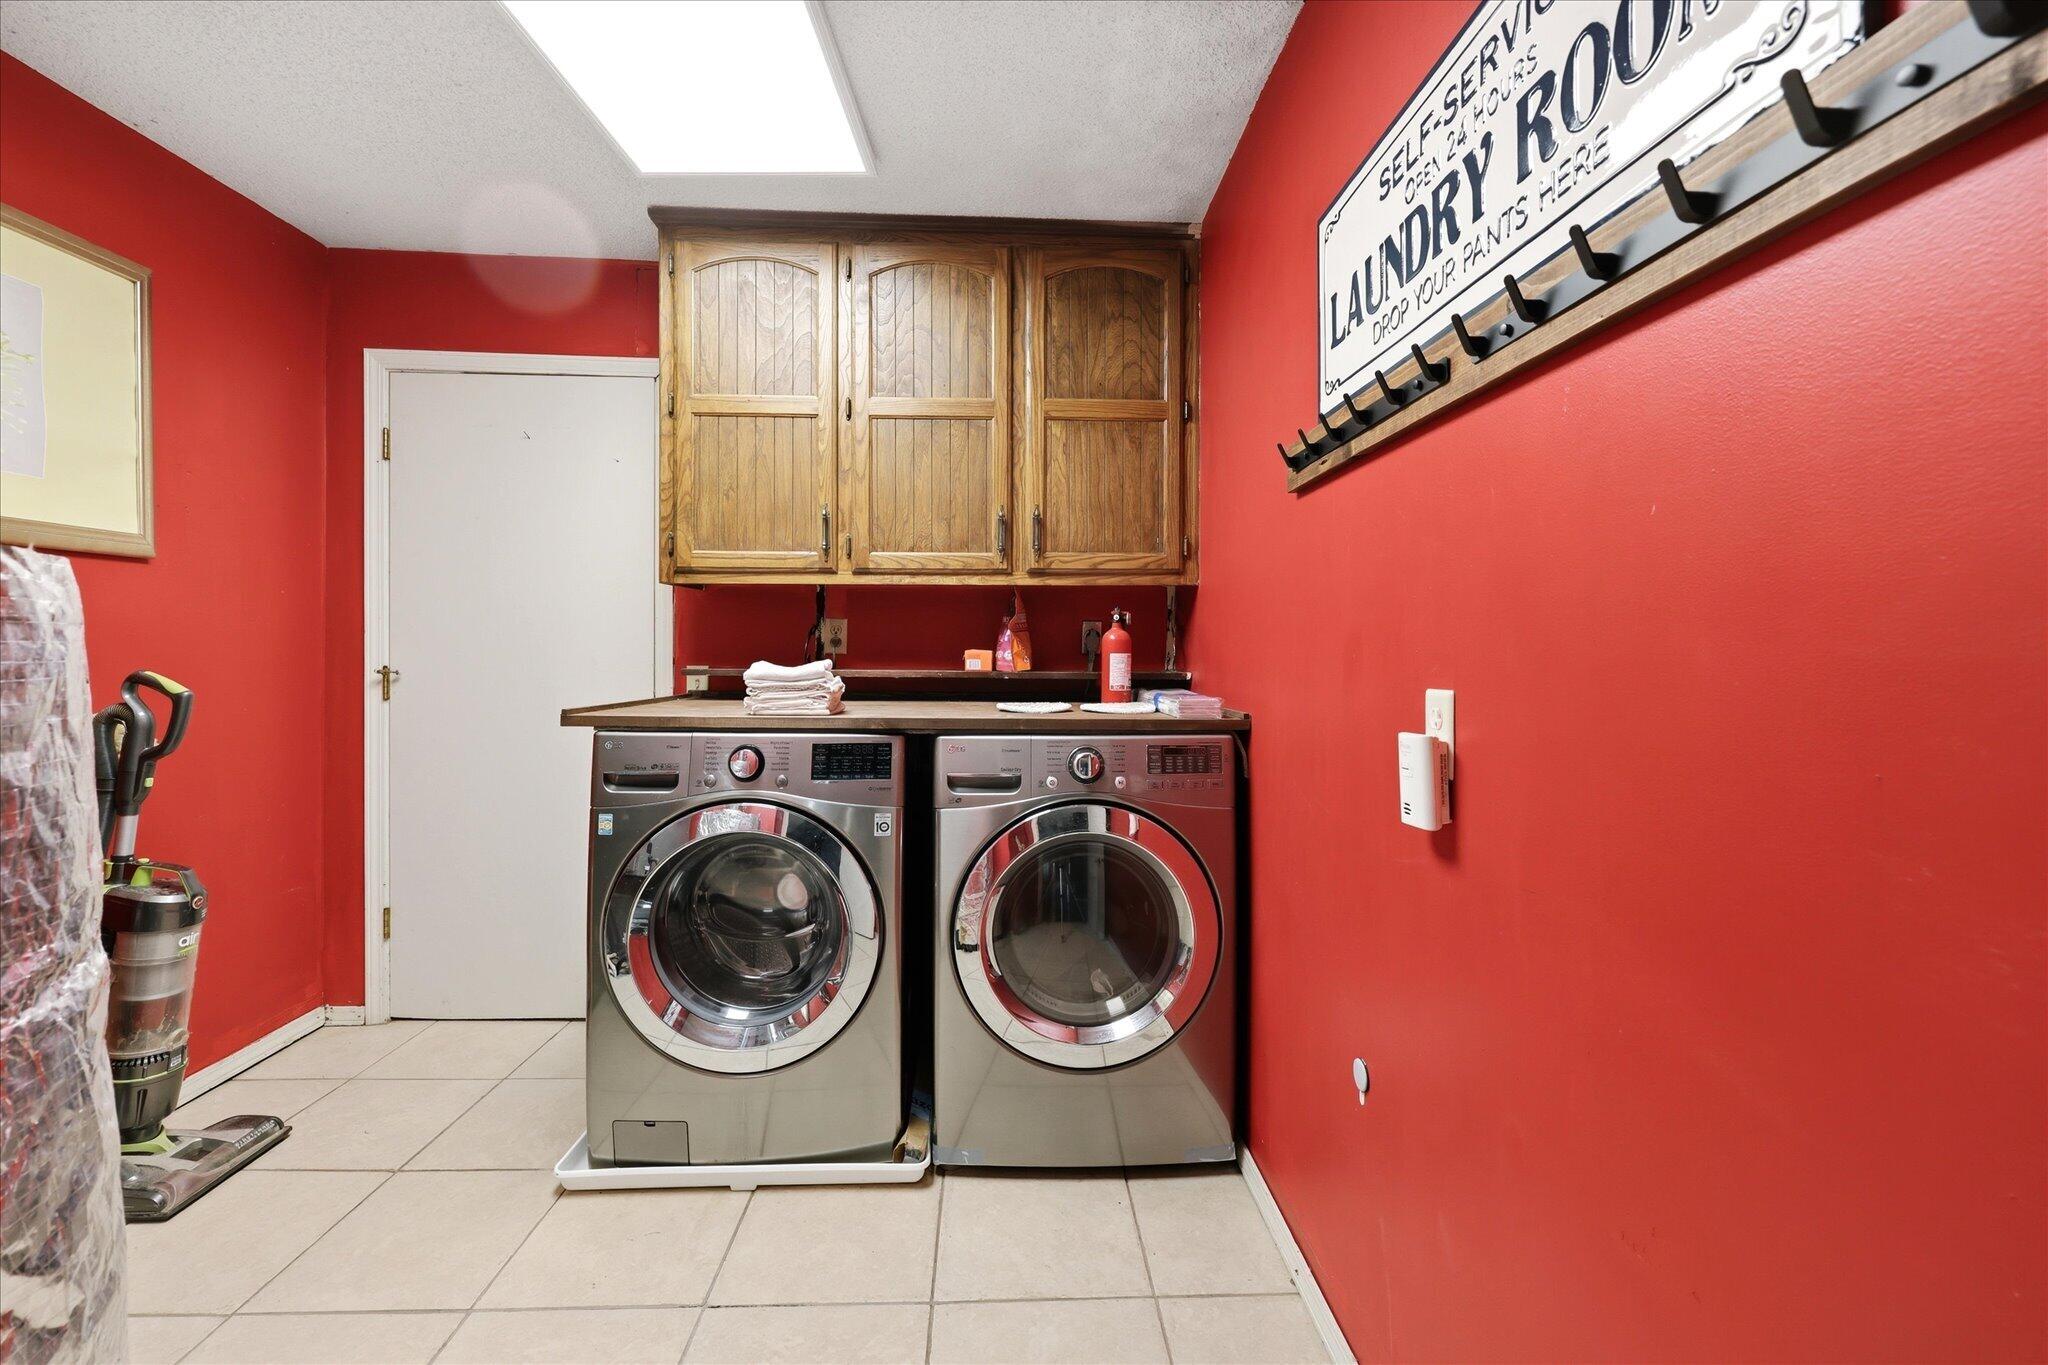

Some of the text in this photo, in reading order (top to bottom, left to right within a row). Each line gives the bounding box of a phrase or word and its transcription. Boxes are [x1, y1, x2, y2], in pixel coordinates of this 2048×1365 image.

[1405, 43, 1539, 204] OPEN 24 HOURS
[1330, 131, 1495, 350] LAUNDRY
[1372, 124, 1612, 346] DROP YOUR PANTS HERE
